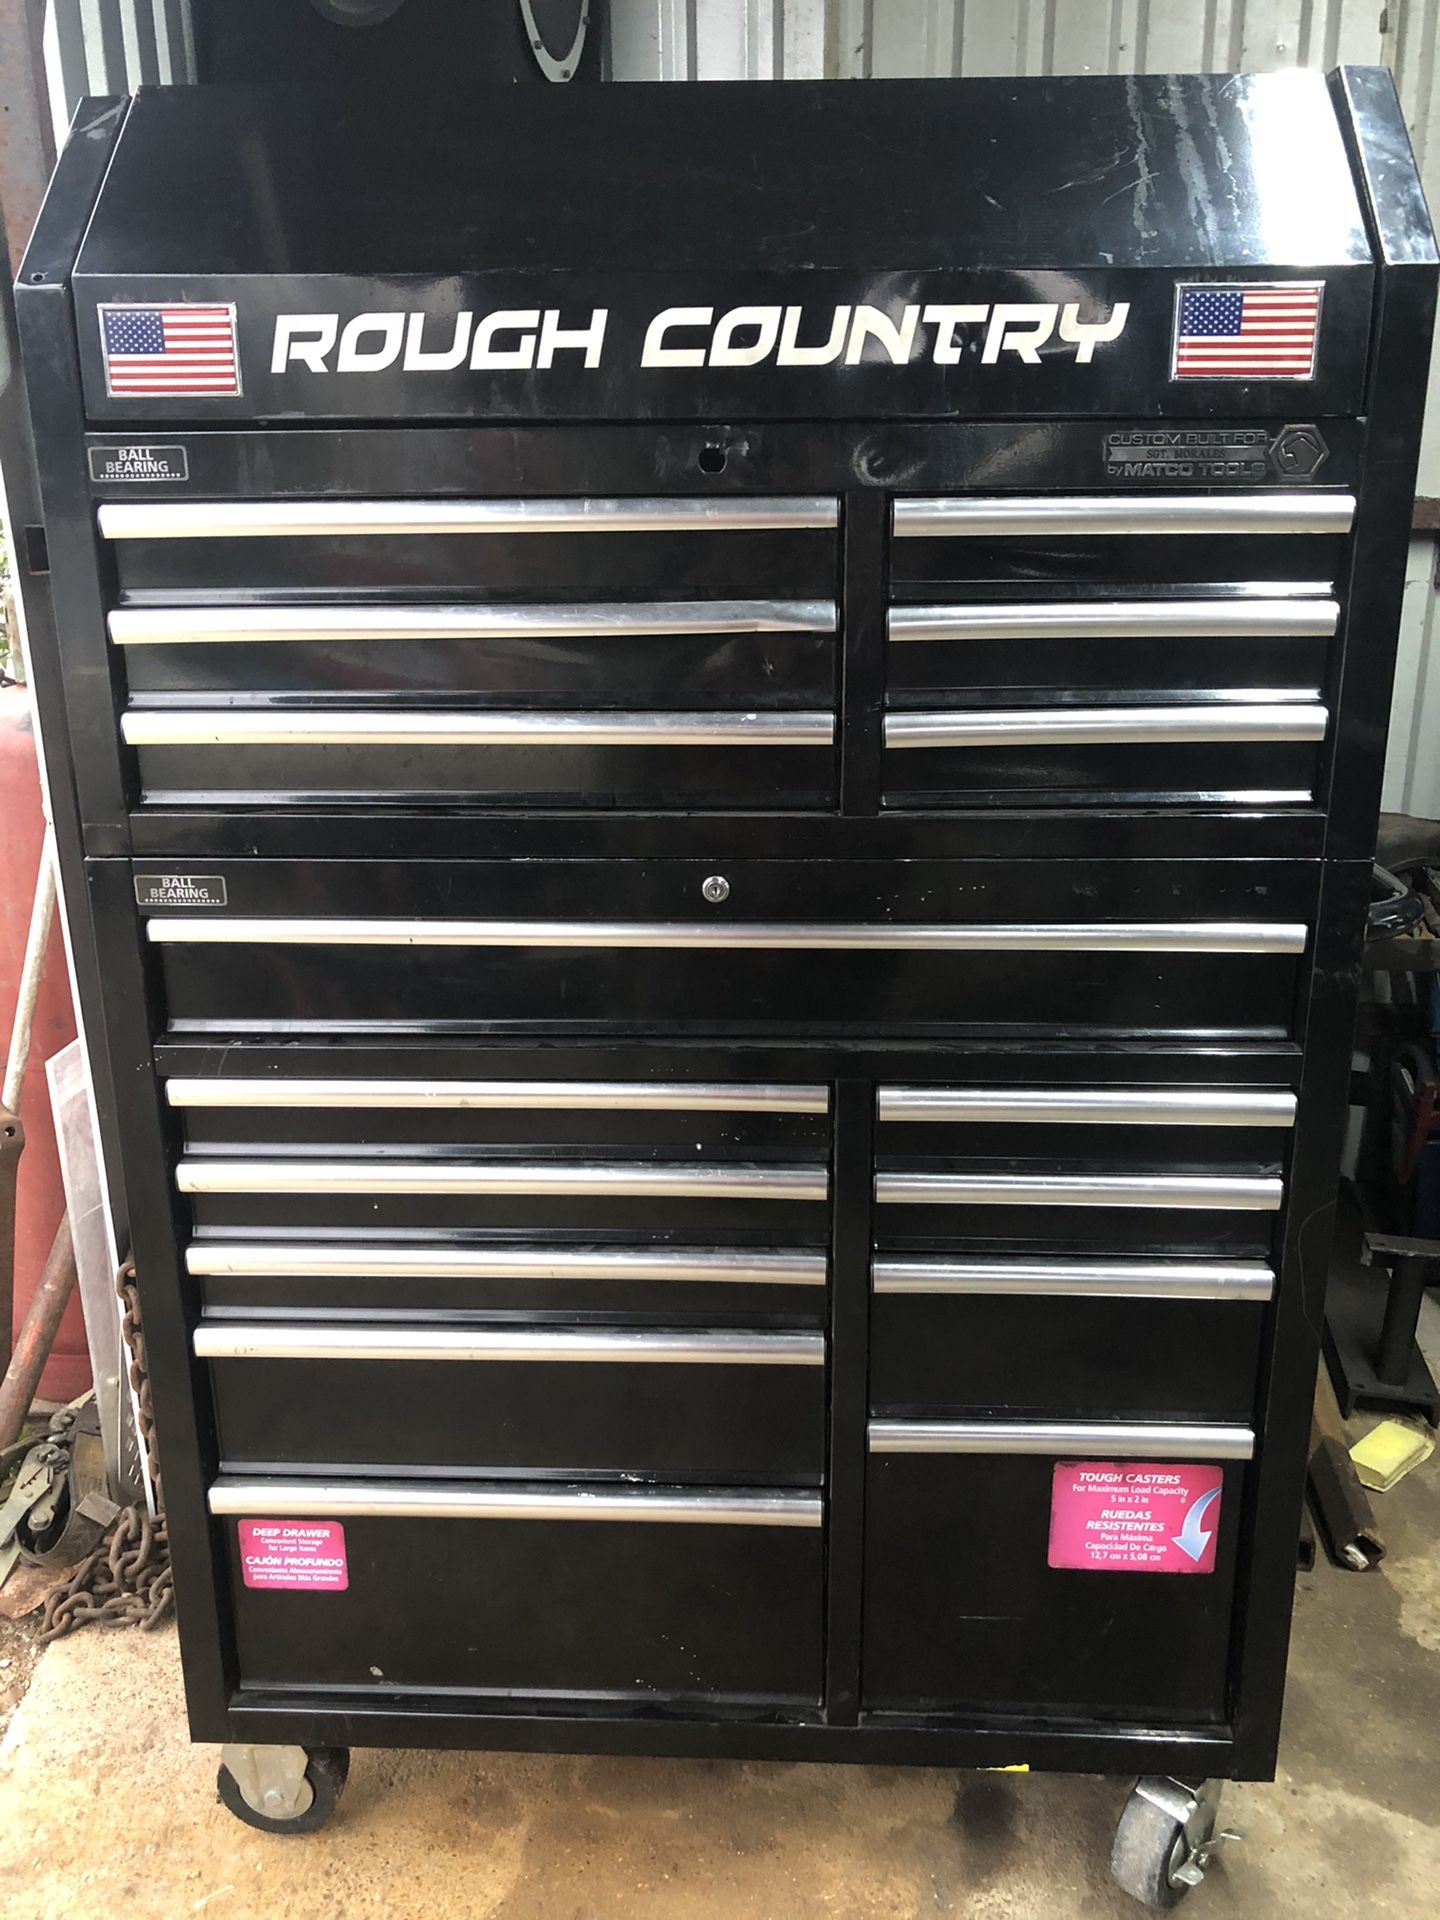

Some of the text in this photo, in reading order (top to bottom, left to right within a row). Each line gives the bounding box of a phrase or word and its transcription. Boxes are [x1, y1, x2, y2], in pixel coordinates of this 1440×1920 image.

[270, 302, 1130, 374] ROUGH COUNTRY
[1108, 433, 1268, 445] CUSTOM BUILT FOR
[118, 449, 154, 460] BALL
[1146, 449, 1226, 458] SGT. MORALES
[105, 461, 168, 473] BEARING
[1107, 462, 1265, 477] by MATCO TOOLS
[162, 878, 195, 888] BALL
[150, 888, 208, 898] BEARING
[1079, 1473, 1181, 1484] TOUGH CASTERS
[1072, 1484, 1189, 1496] For Maximum Load Capacity
[1101, 1510, 1152, 1520] RUEDAS
[1086, 1521, 1165, 1531] RESISTENTES
[252, 1528, 331, 1537] DEEP DRAWER
[1100, 1533, 1118, 1541] Para
[1085, 1541, 1128, 1551] Capacidad
[1143, 1543, 1167, 1552] Carga
[246, 1554, 343, 1566] CAJÓN PROFUNDO
